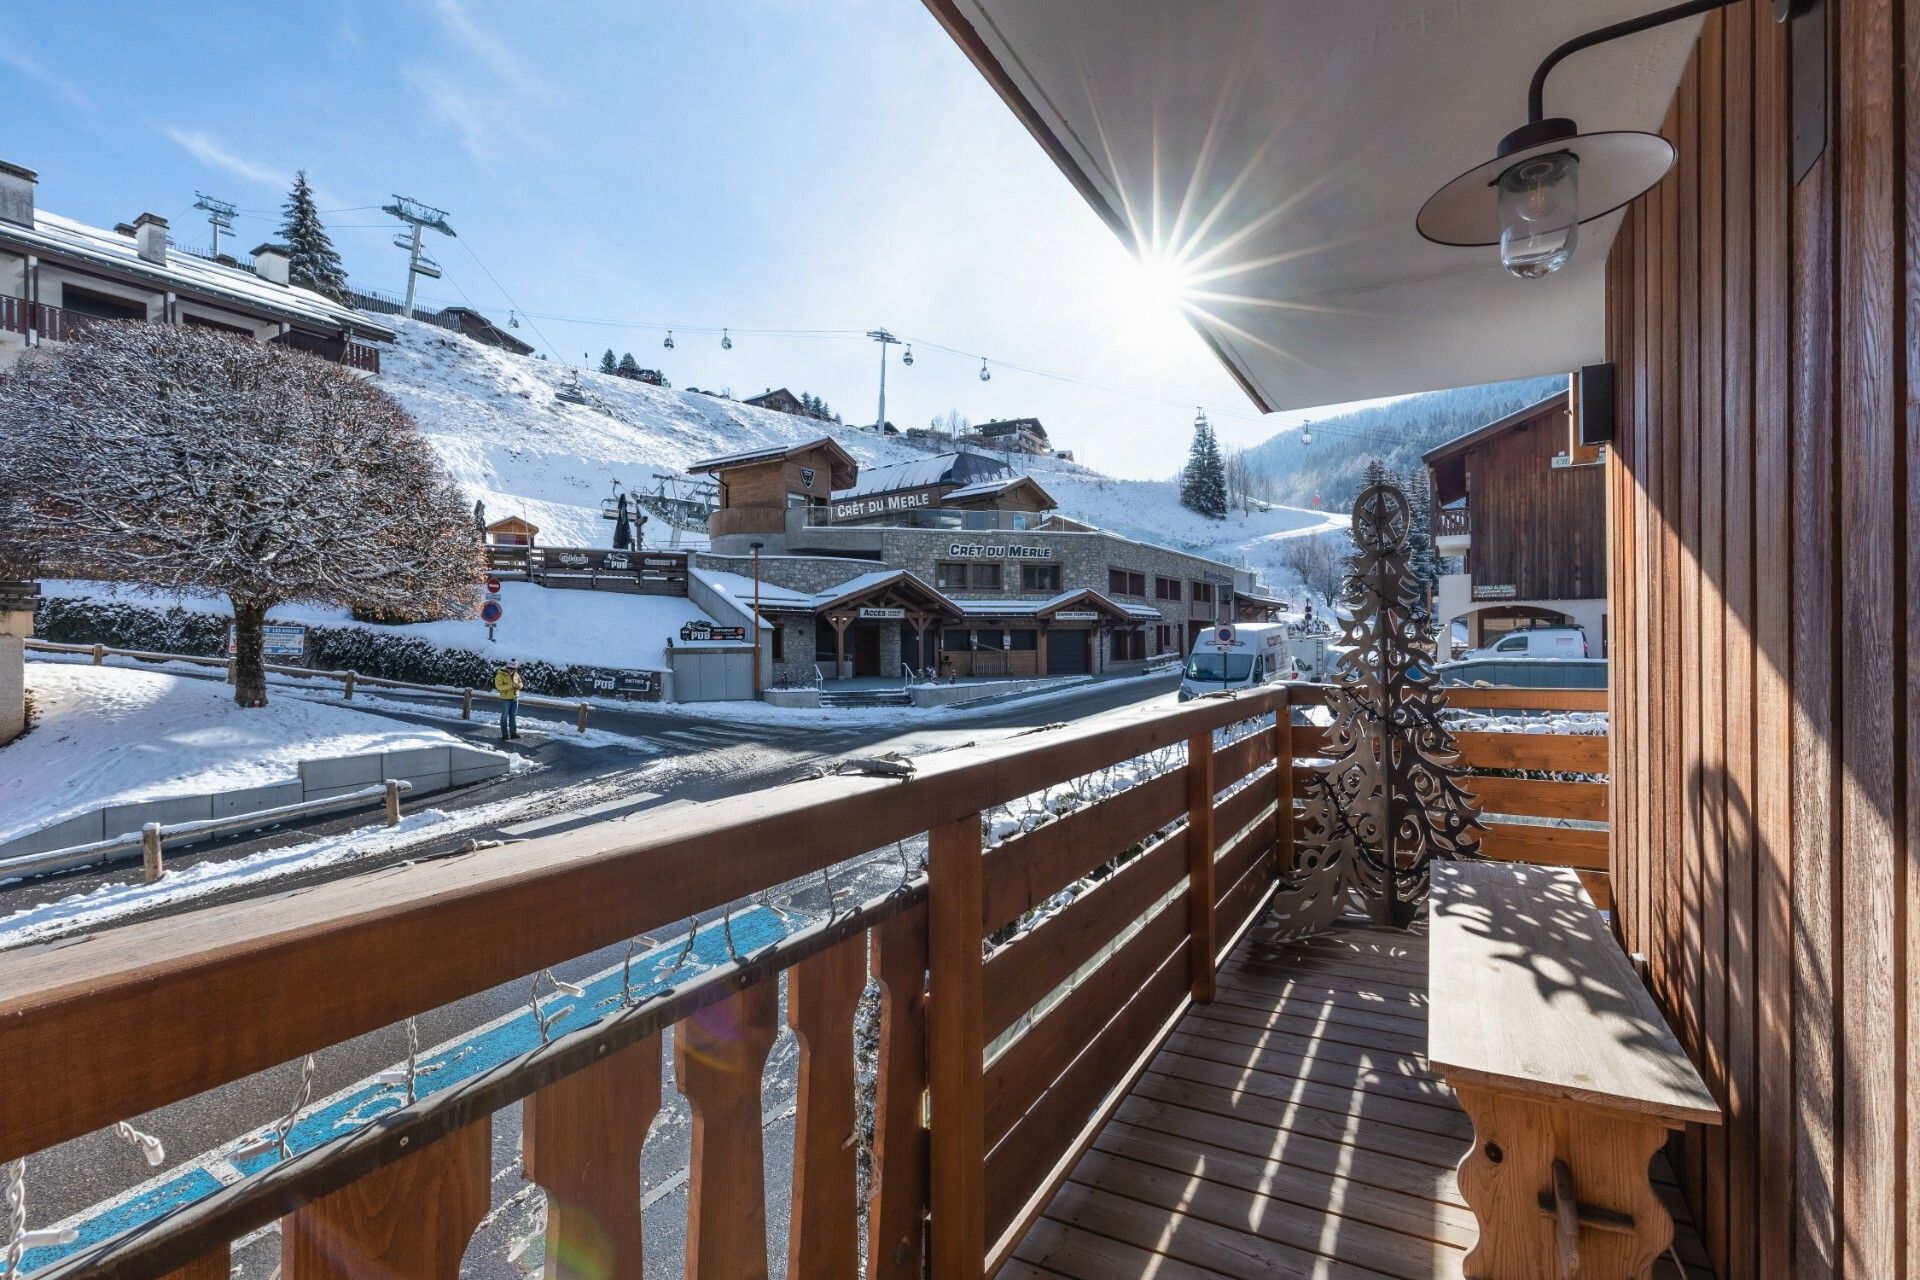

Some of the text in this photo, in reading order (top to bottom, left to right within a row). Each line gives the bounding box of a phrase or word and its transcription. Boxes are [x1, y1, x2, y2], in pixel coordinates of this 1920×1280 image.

[868, 500, 884, 513] DU
[887, 493, 930, 509] MERLE
[985, 545, 1006, 558] DU
[1007, 544, 1052, 558] MERLE
[611, 560, 628, 569] PUB
[691, 631, 711, 640] PUB
[593, 679, 615, 689] PUB
